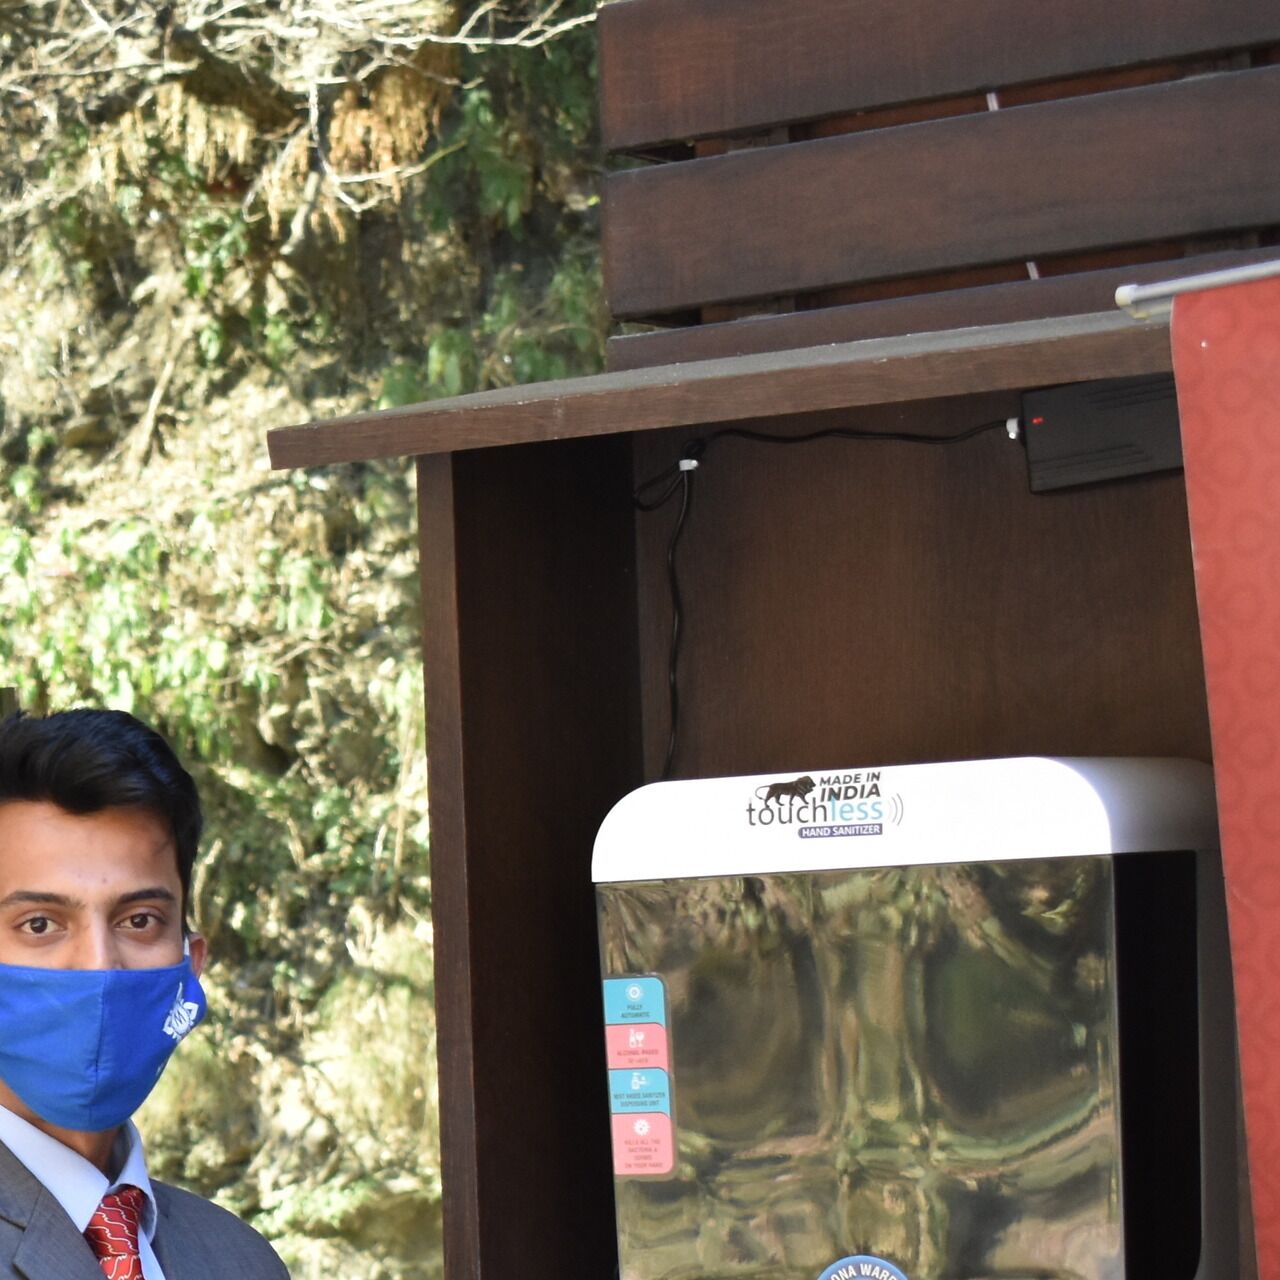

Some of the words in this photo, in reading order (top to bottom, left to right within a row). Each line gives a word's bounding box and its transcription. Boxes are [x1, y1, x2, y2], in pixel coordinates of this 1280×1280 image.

[819, 773, 862, 786] MADE
[866, 771, 881, 782] IN
[820, 783, 881, 802] INDIA
[746, 795, 883, 826] touchless
[801, 827, 831, 838] HAND
[832, 825, 880, 836] SANITIZER
